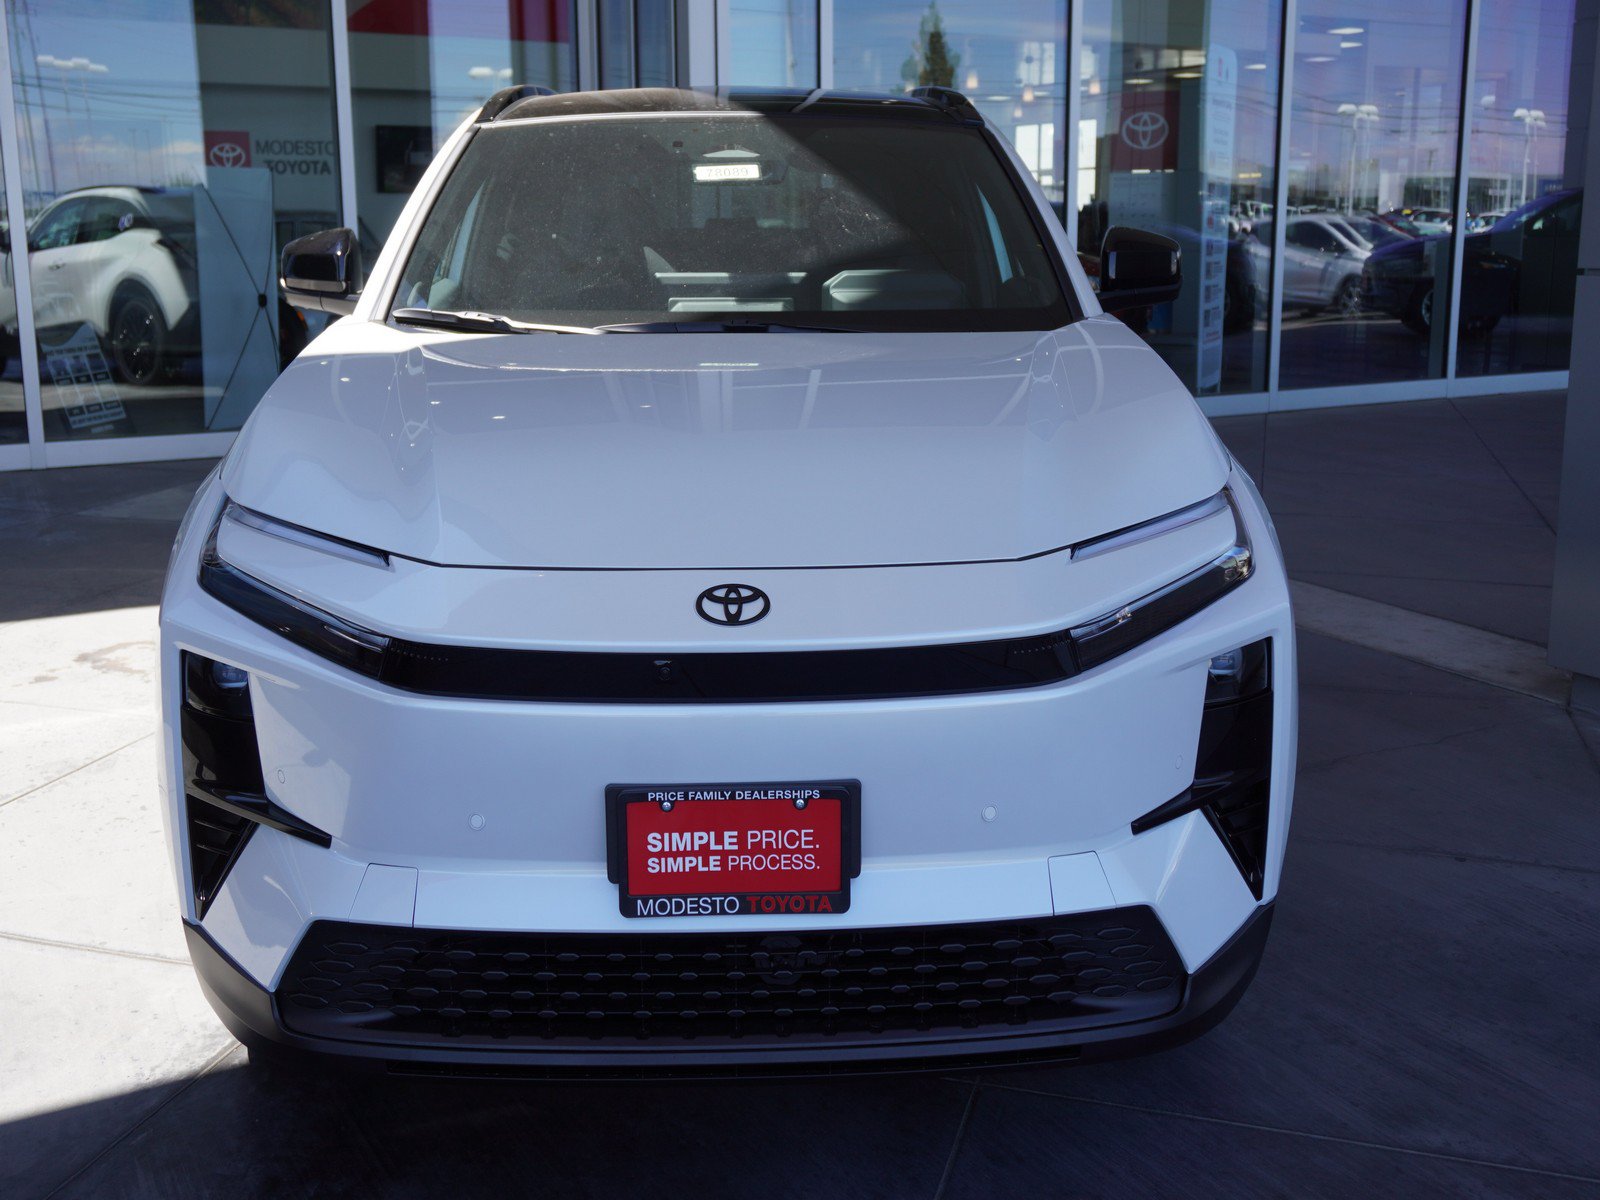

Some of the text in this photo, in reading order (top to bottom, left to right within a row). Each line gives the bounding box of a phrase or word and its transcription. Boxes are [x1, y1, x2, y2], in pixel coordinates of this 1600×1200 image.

[647, 789, 820, 802] PRICE FAMILY DEALERSHIPS
[647, 829, 820, 852] SIMPLE PRICE.
[647, 854, 820, 873] SIMPLE PROCESS.
[637, 896, 833, 916] MODESTO TOYOTA
